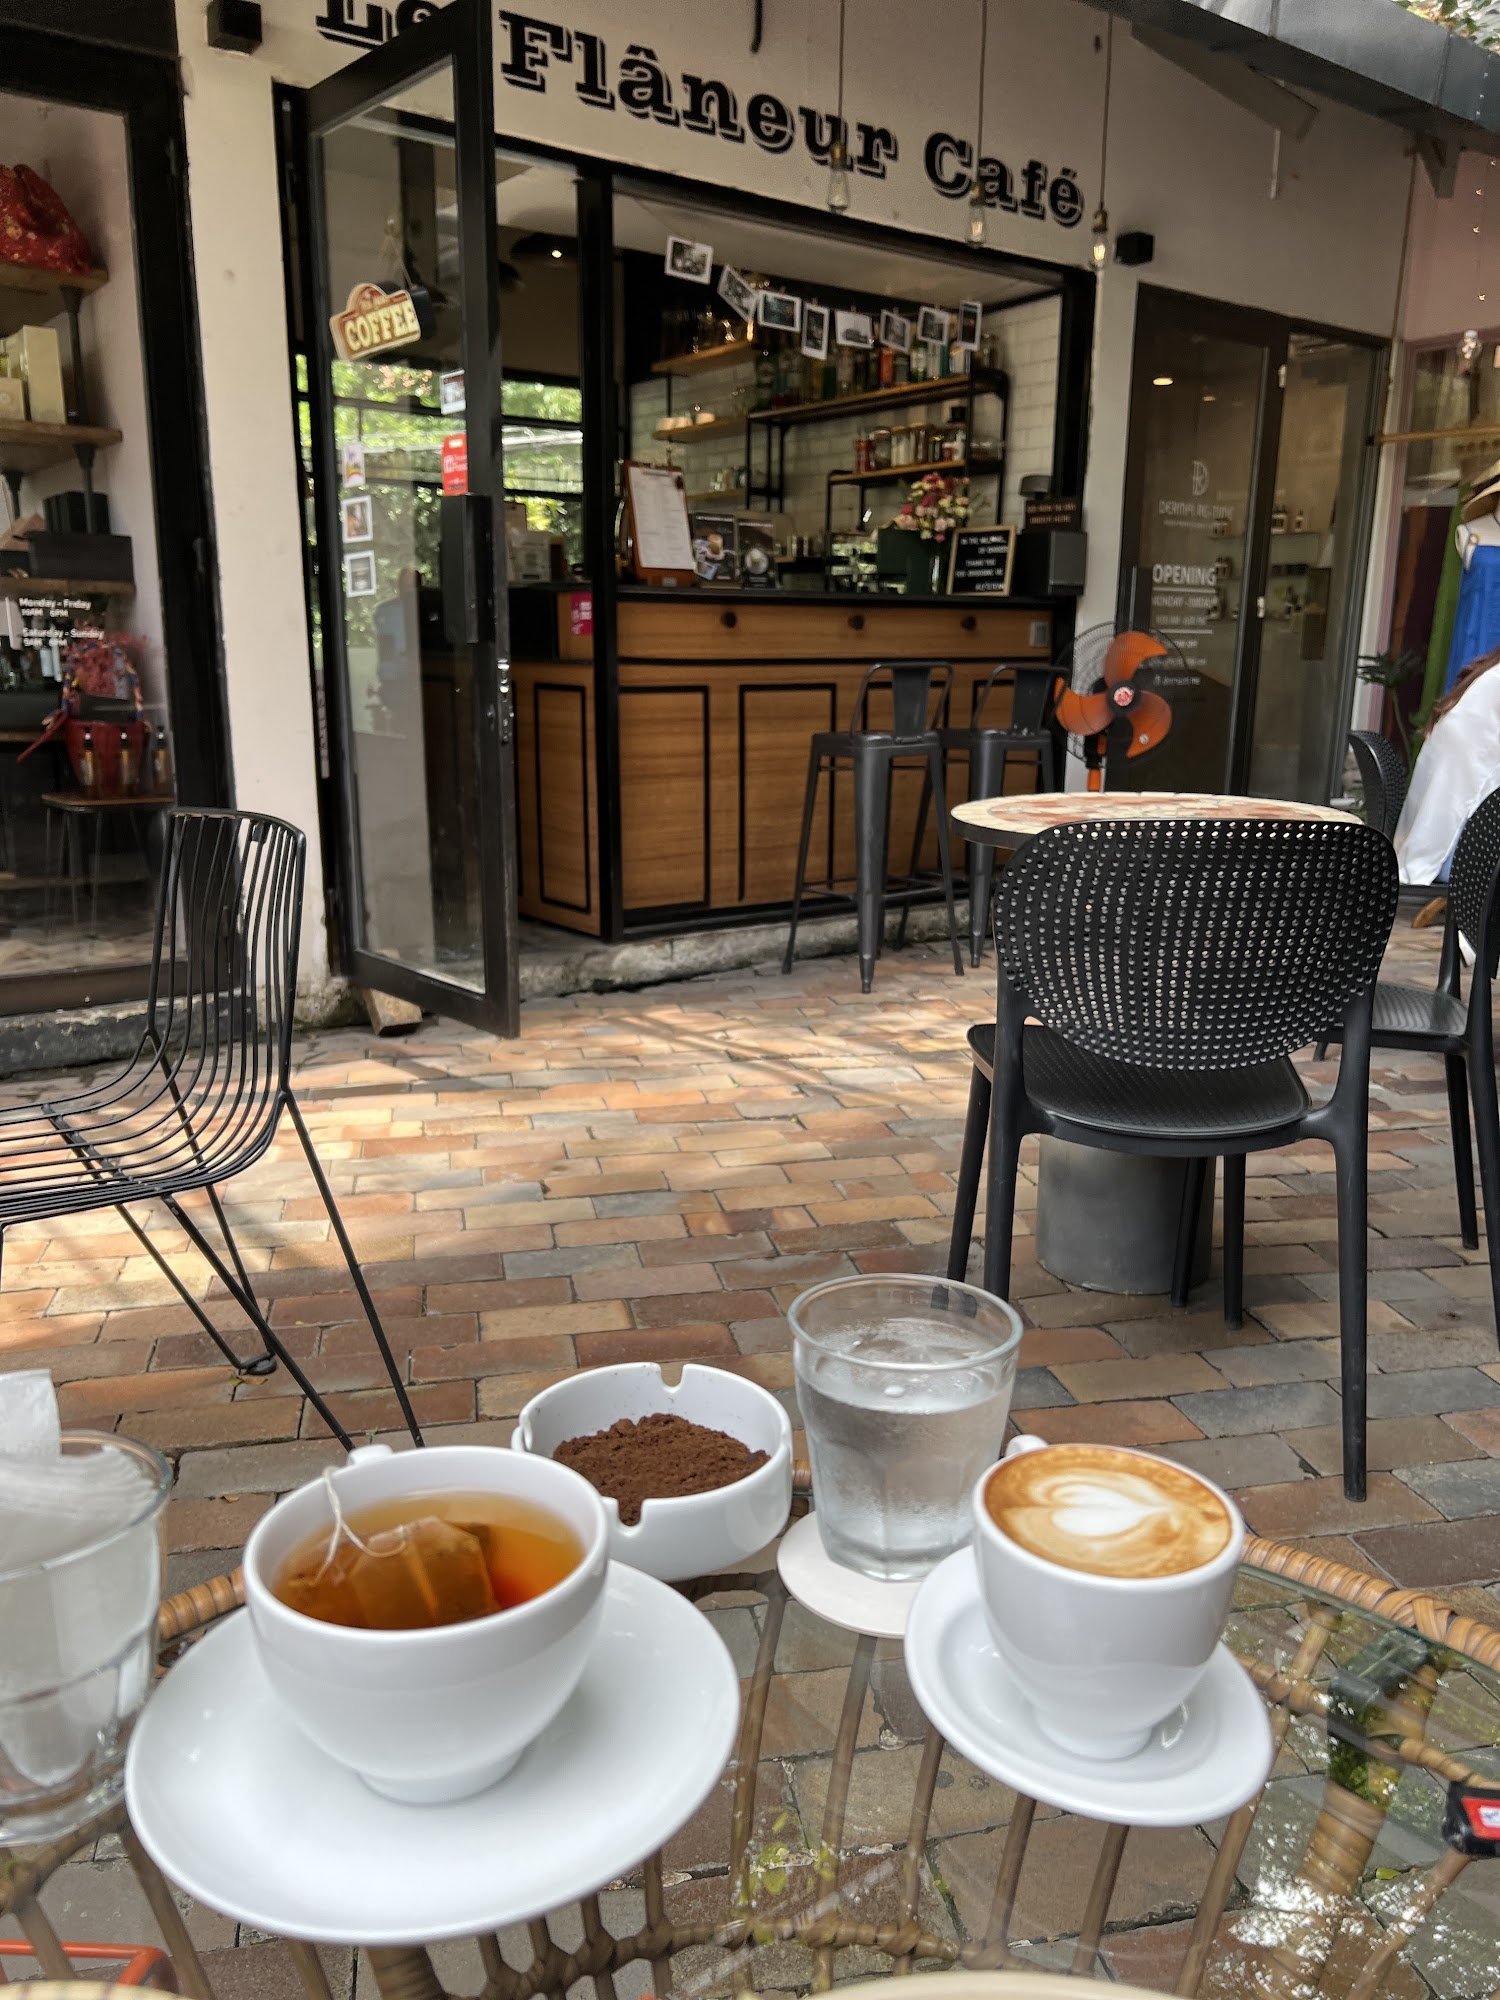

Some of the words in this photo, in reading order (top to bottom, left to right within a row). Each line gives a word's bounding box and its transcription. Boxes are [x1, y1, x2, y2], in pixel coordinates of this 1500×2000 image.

[498, 8, 898, 178] Flâneur
[923, 130, 1084, 225] Café
[344, 300, 420, 352] COFFEE
[1152, 563, 1217, 586] OPENING
[19, 598, 57, 609] Monday
[63, 599, 92, 611] Friday
[22, 627, 64, 639] Saturday
[70, 628, 105, 641] Sunday
